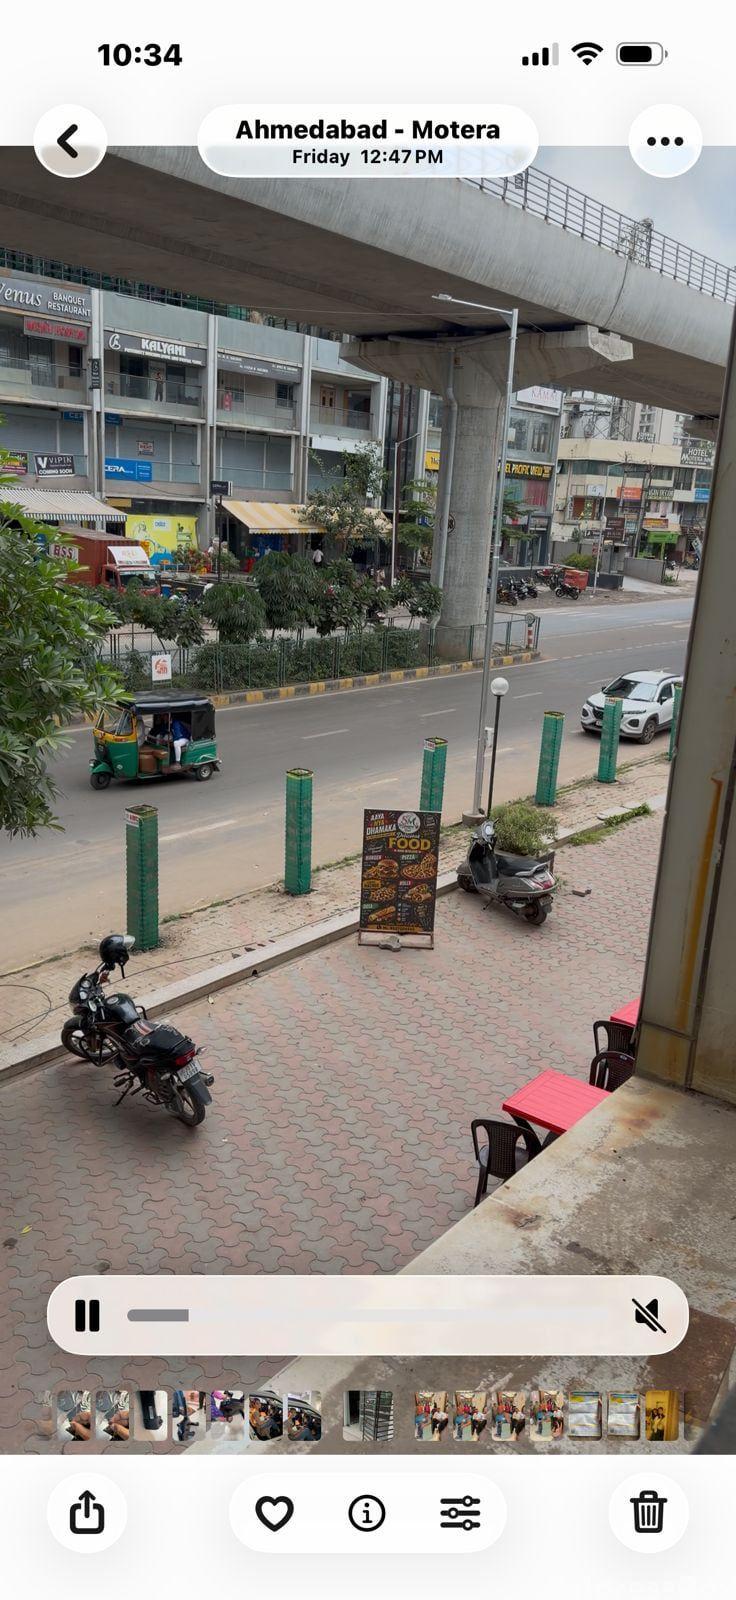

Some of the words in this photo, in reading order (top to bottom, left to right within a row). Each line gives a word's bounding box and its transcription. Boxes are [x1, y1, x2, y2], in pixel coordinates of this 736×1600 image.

[53, 291, 85, 306] BANQUET
[47, 301, 91, 317] RESTAURANT
[688, 448, 708, 457] HOTEL
[49, 456, 72, 464] VIPIN
[53, 544, 74, 560] BSS
[366, 823, 397, 836] DHAMAKA
[388, 837, 431, 851] FOOD
